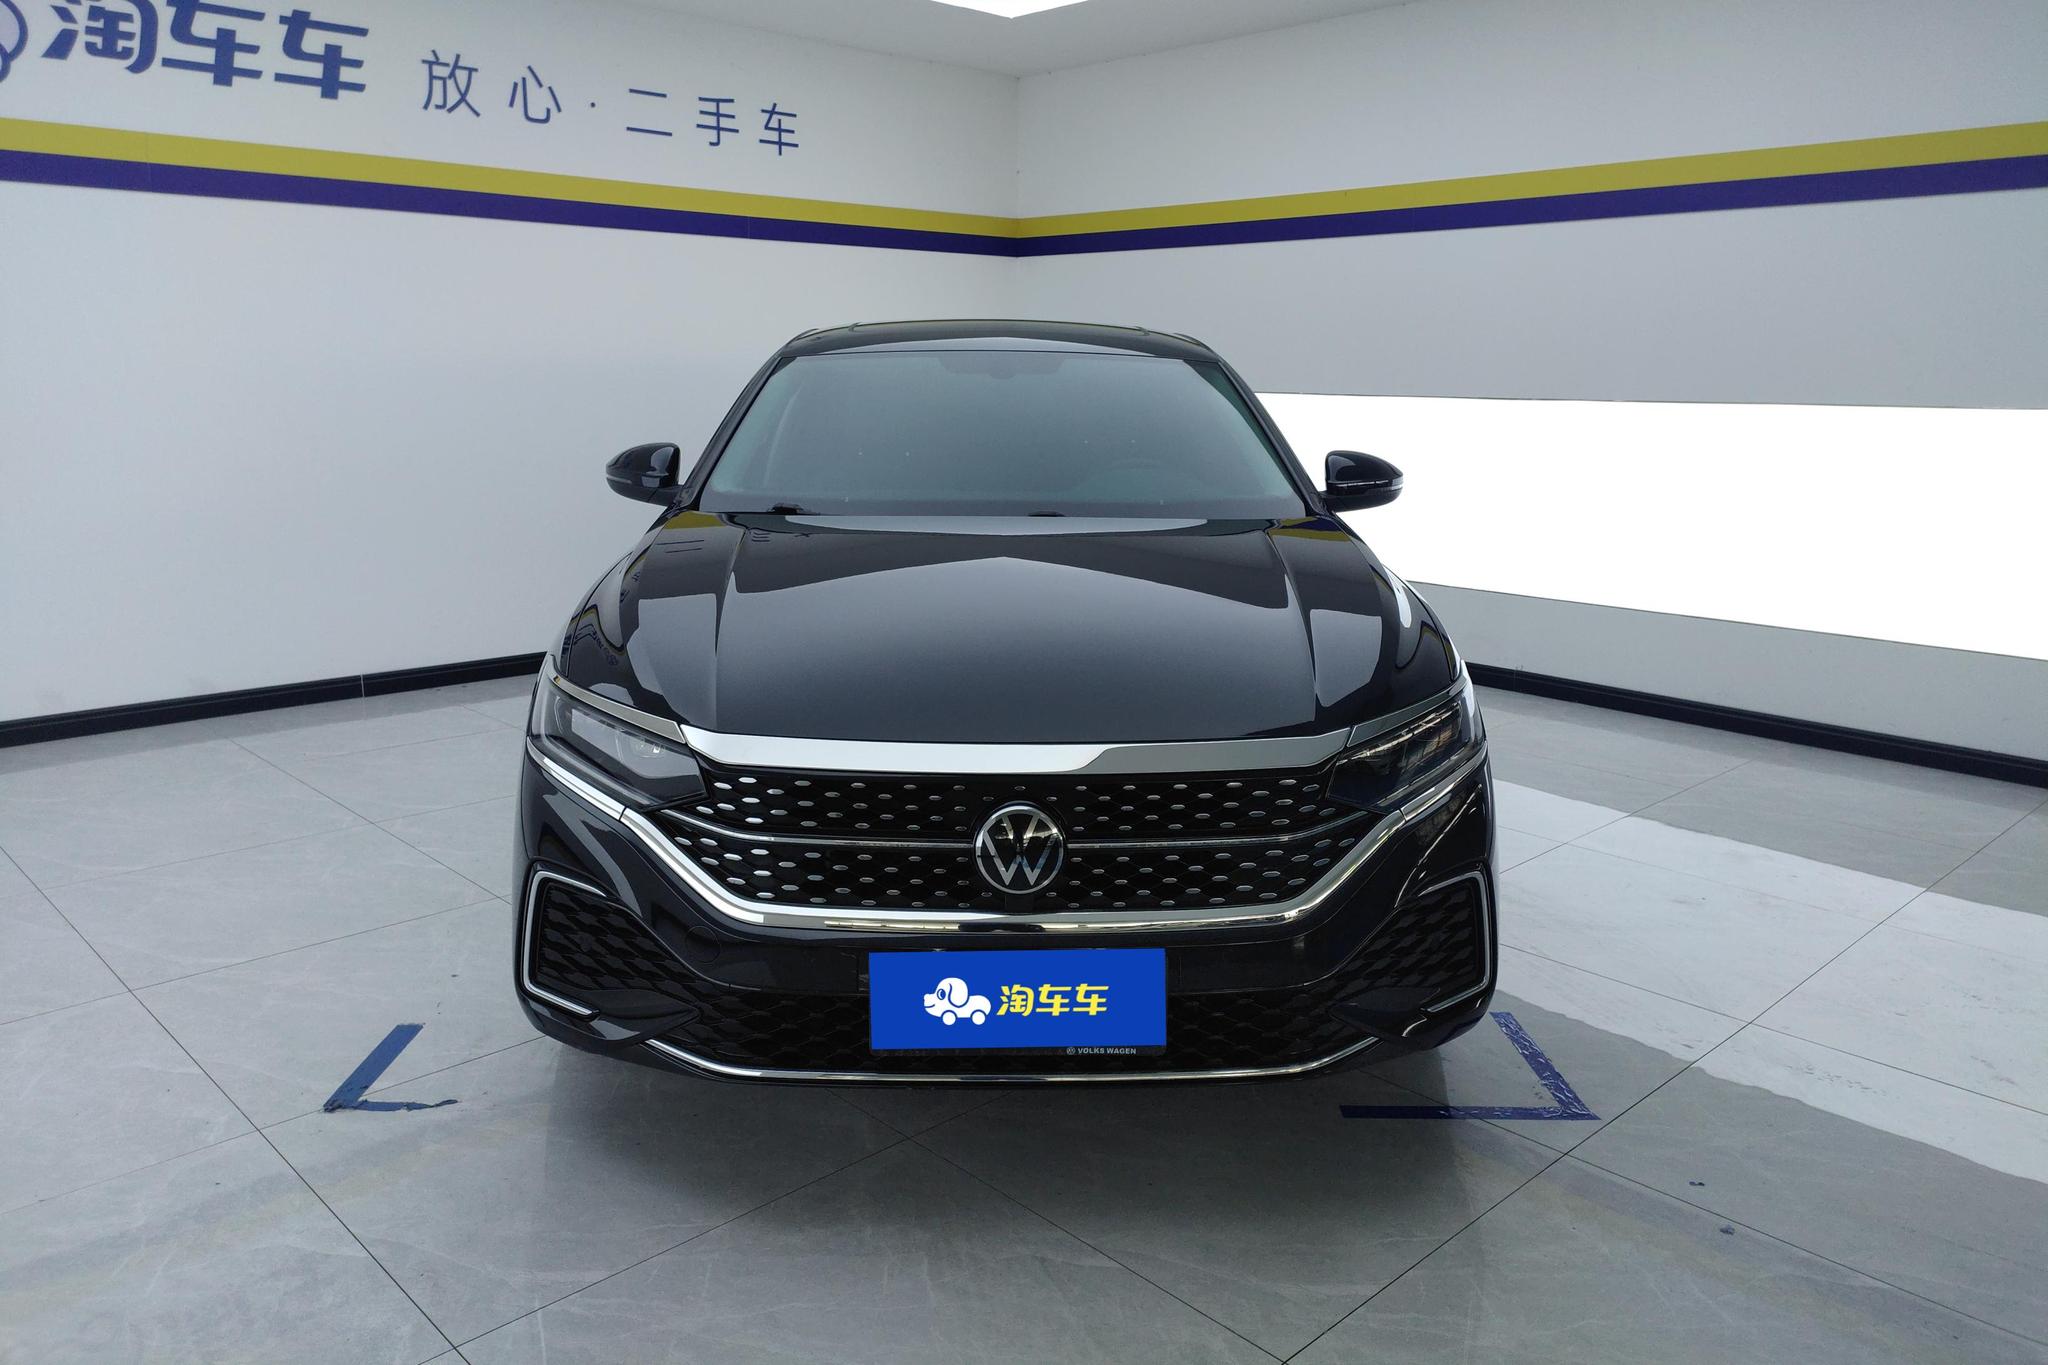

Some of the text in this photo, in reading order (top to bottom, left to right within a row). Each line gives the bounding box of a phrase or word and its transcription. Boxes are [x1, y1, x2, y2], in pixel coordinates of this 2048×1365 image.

[41, 0, 369, 99] 淘车车
[1077, 1047, 1105, 1055] VOLKS
[1106, 1047, 1137, 1055] WAGEN
